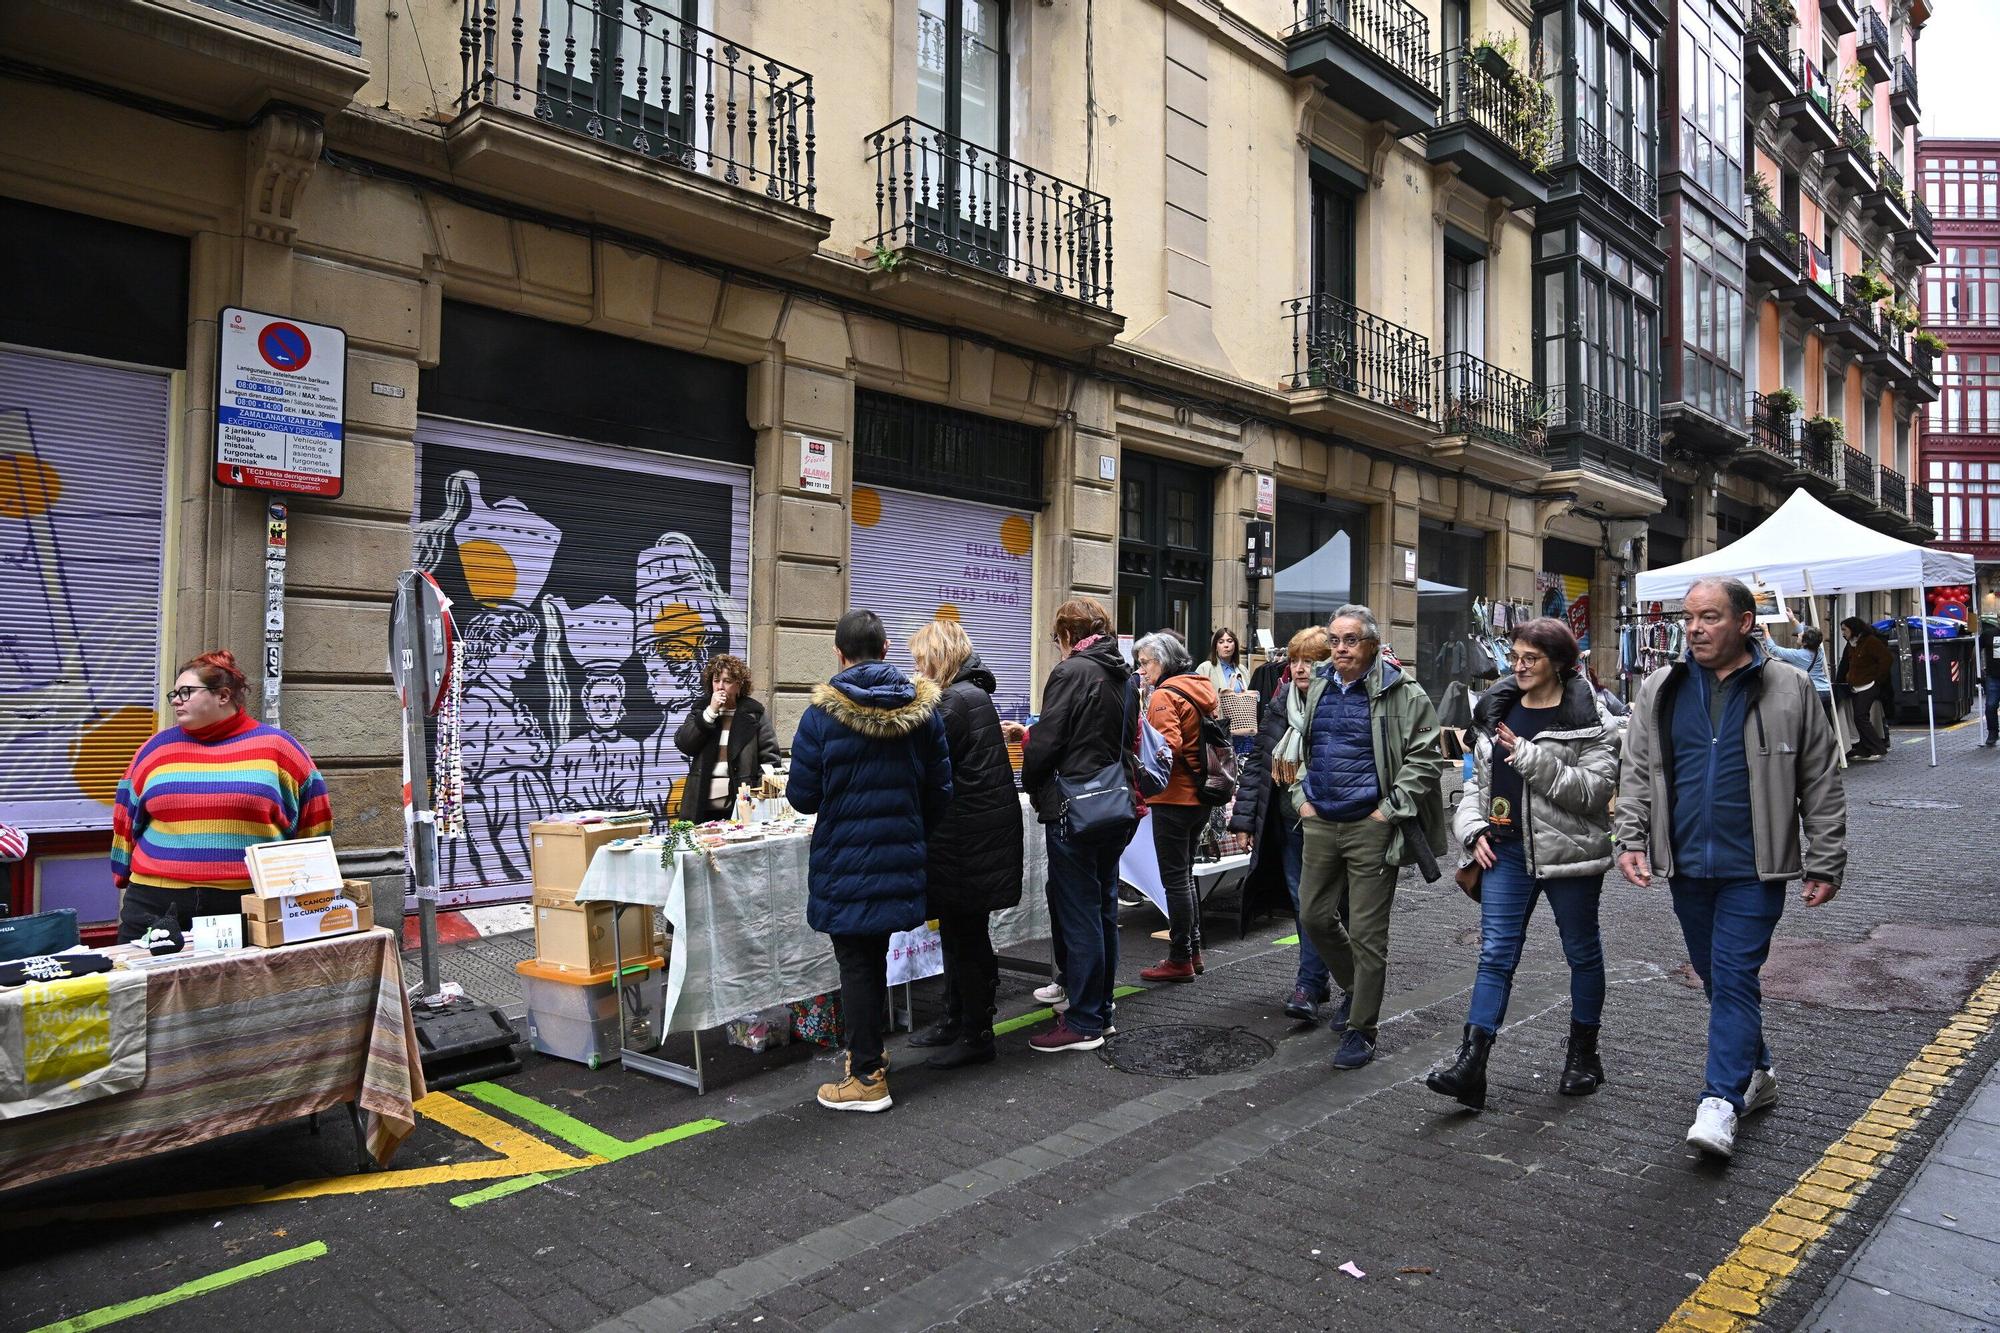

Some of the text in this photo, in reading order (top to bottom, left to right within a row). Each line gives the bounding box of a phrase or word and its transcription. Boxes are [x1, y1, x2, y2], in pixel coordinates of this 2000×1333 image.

[237, 365, 330, 385] Lanegunetan astelehenetik barikura
[238, 381, 257, 390] 08:00
[264, 386, 282, 394] 19:00
[247, 375, 274, 385] Laborables
[302, 384, 320, 392] viernes
[225, 388, 248, 397] Lanegun
[263, 395, 290, 404] zapatuetan
[315, 402, 338, 411] laborables
[237, 398, 257, 406] 08:00
[263, 402, 281, 411] 14:00
[240, 410, 324, 428] ZAMALANAK IZAN EZIK
[228, 418, 263, 428] EXCEPTO
[264, 422, 288, 432] CARGA
[296, 426, 334, 439] DESCARGA
[230, 427, 266, 437] jarlekuko
[225, 434, 254, 443] ibilgailu
[293, 436, 327, 446] Vehículos
[224, 442, 256, 452] mistoak,
[293, 444, 316, 452] mixtos
[224, 448, 264, 459] furgonetak
[293, 450, 322, 459] asientos
[224, 455, 257, 465] kamioiak
[292, 457, 330, 468] furgonetas
[298, 466, 332, 475] camiones
[803, 468, 830, 478] ALARMA
[284, 472, 328, 483] derrigorrezkoa
[254, 478, 271, 486] Tique
[291, 482, 320, 490] obligatorio
[303, 895, 344, 906] CANCIONES
[300, 906, 330, 916] CUANDO
